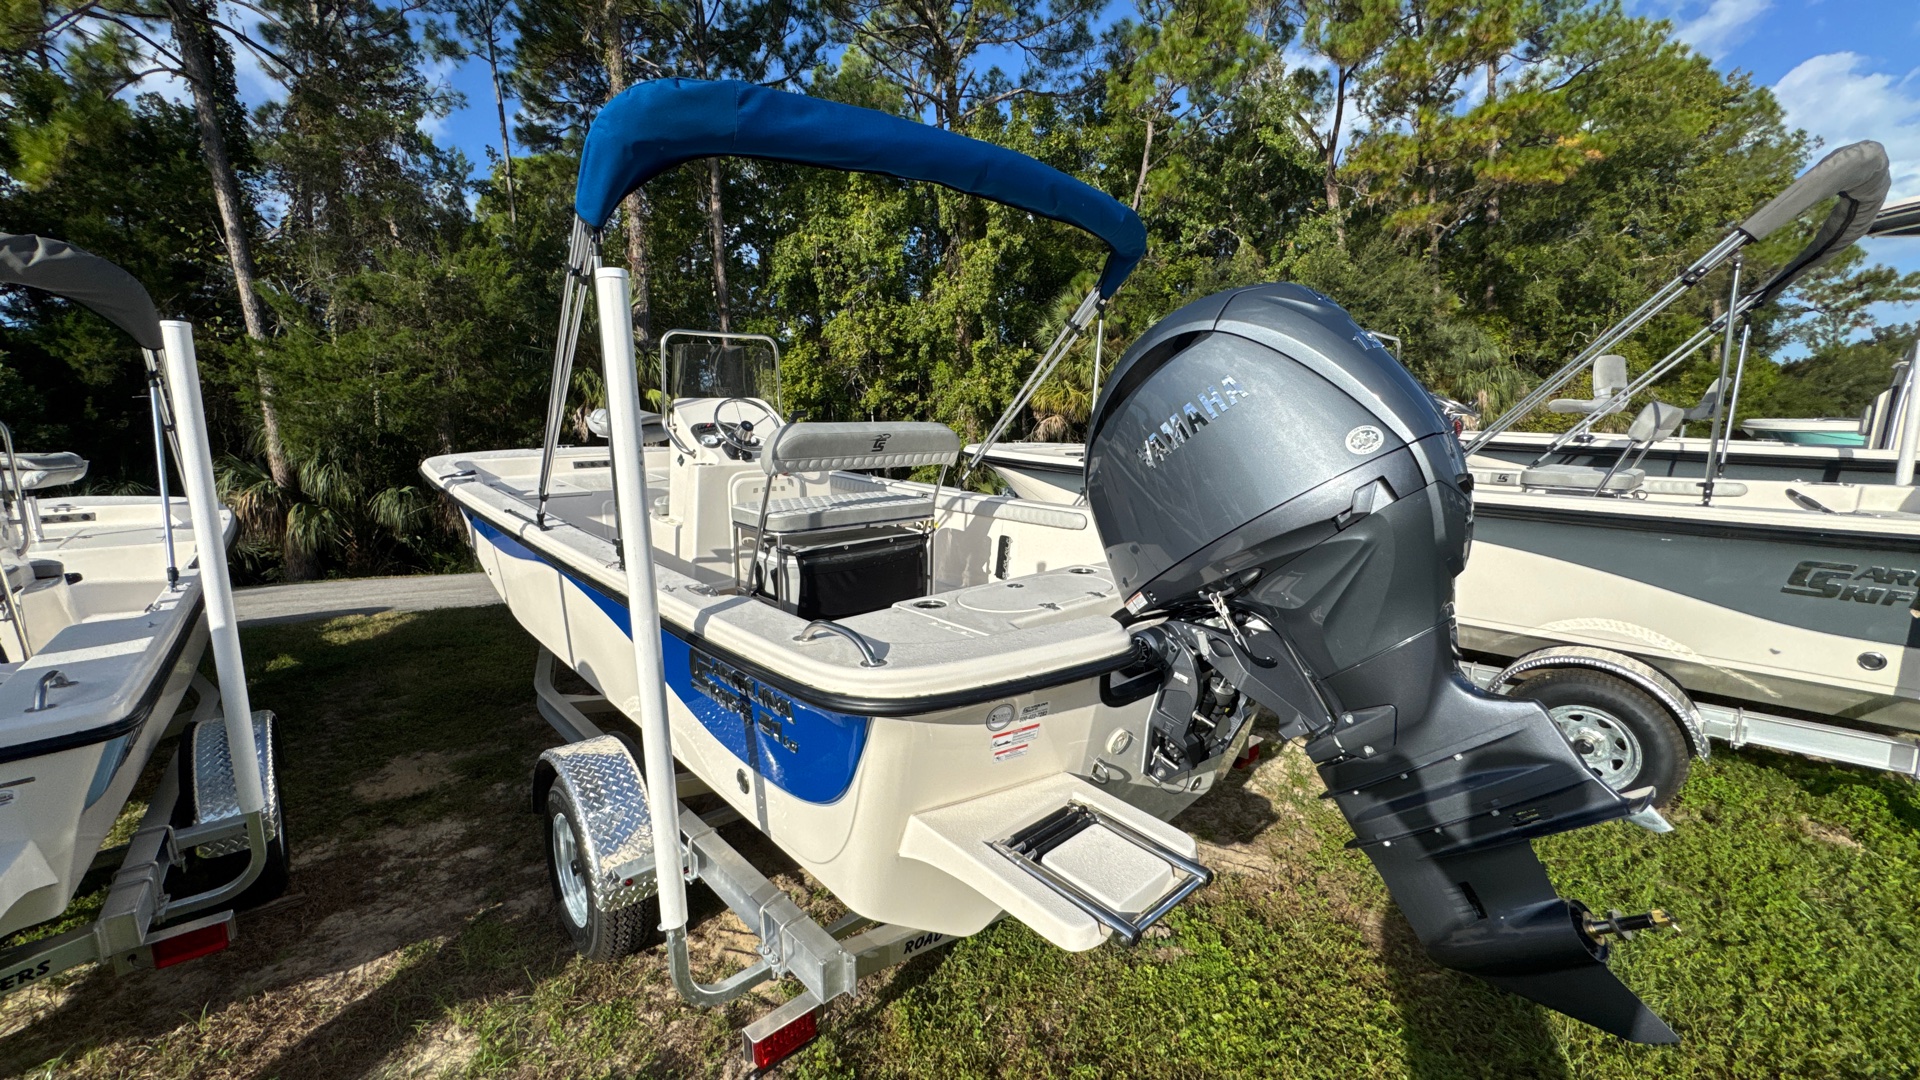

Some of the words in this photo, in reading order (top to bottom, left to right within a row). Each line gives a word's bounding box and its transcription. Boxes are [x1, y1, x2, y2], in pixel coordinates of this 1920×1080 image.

[1135, 374, 1249, 469] YAMAHA
[1786, 560, 1920, 588] CAR
[689, 646, 796, 726] CAROLINA
